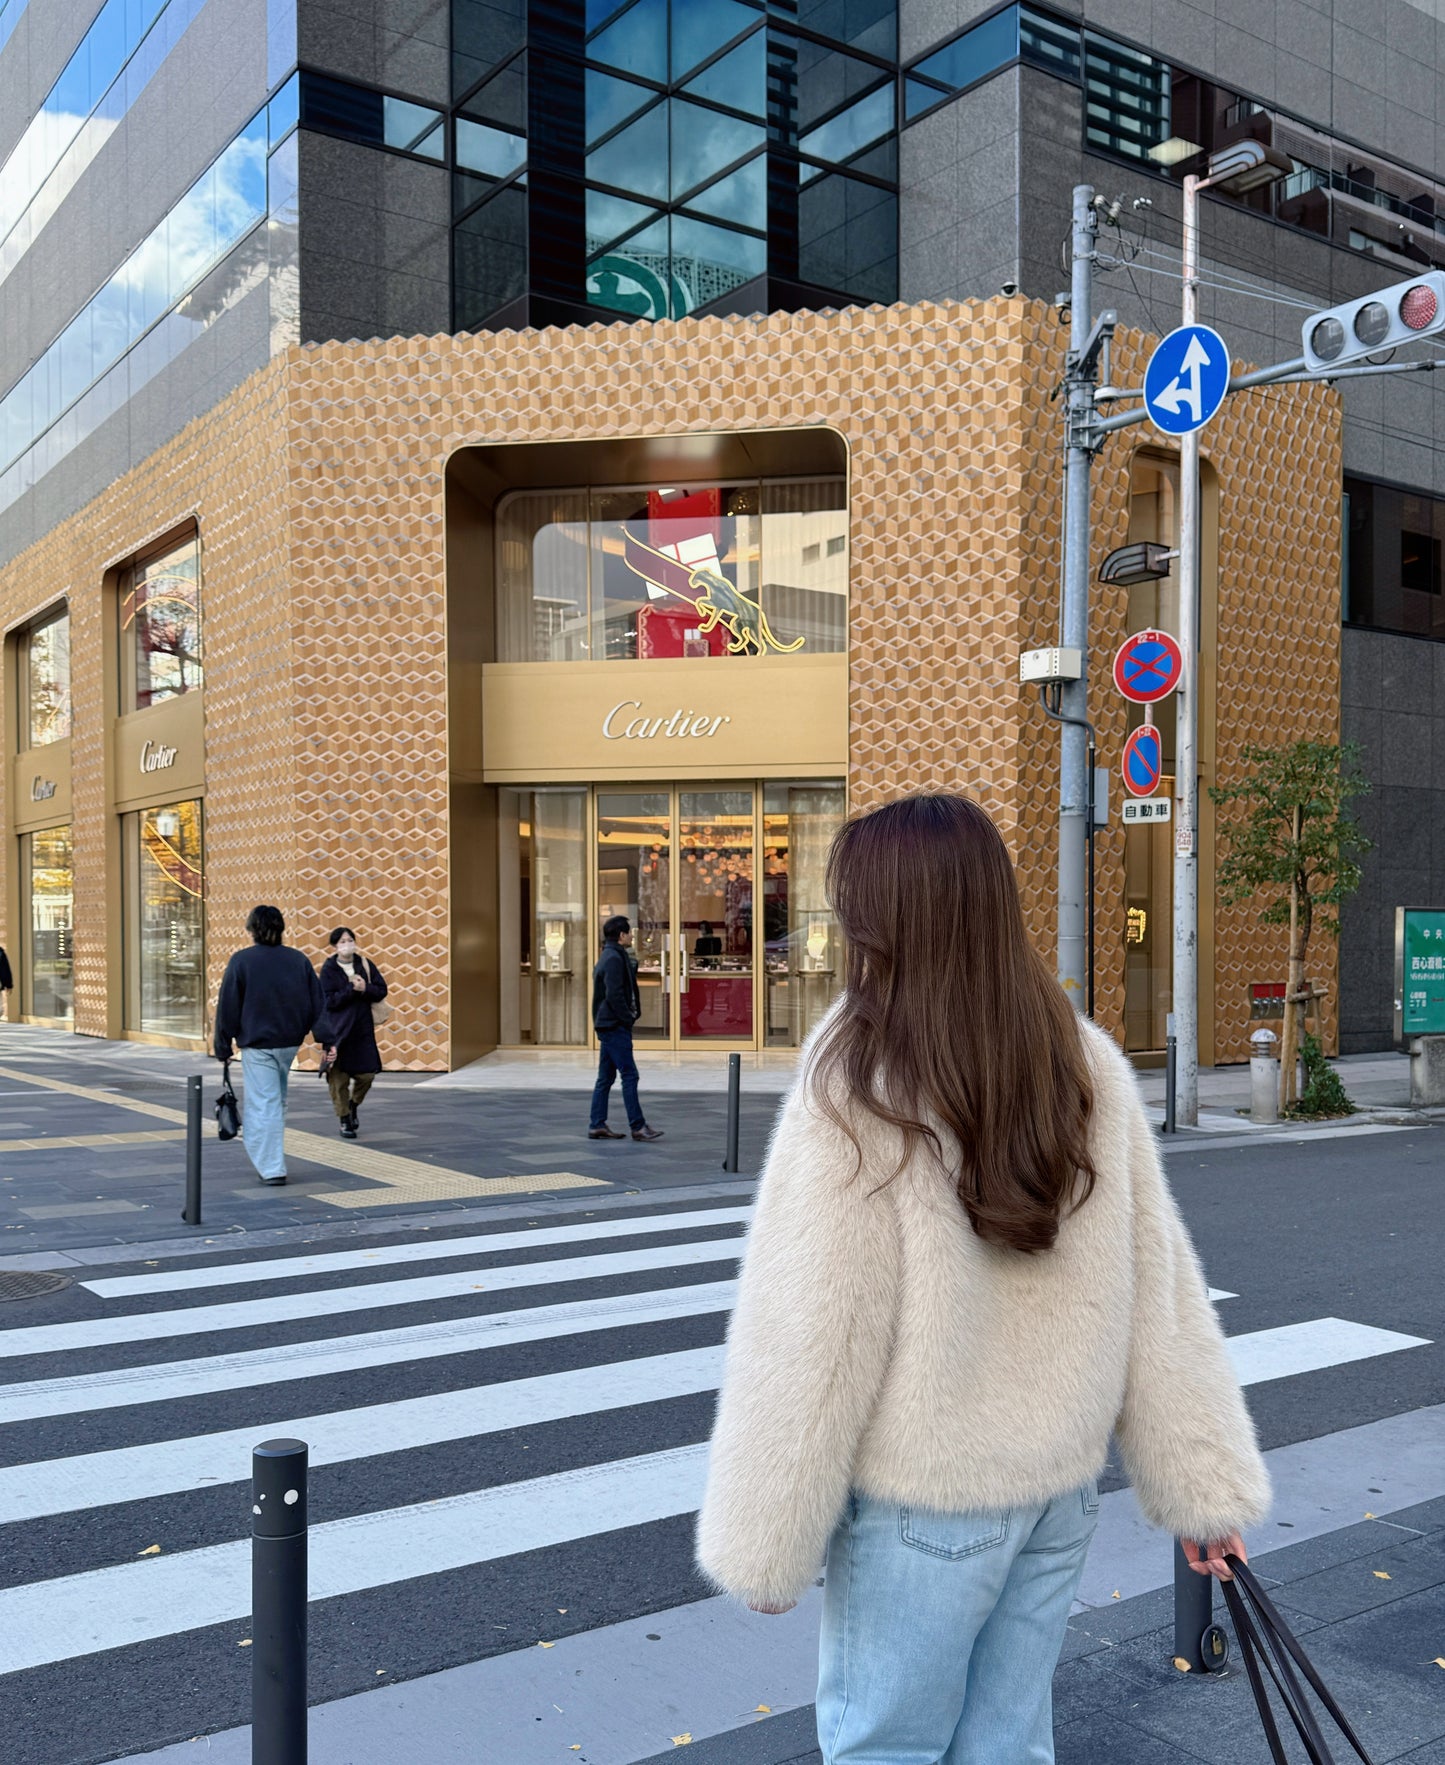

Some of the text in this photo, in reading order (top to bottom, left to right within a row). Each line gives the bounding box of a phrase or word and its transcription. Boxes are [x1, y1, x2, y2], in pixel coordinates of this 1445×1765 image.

[602, 700, 731, 739] Cartier
[139, 740, 178, 773] Cartier
[31, 775, 57, 802] Cartier
[1125, 803, 1168, 818] 自動車
